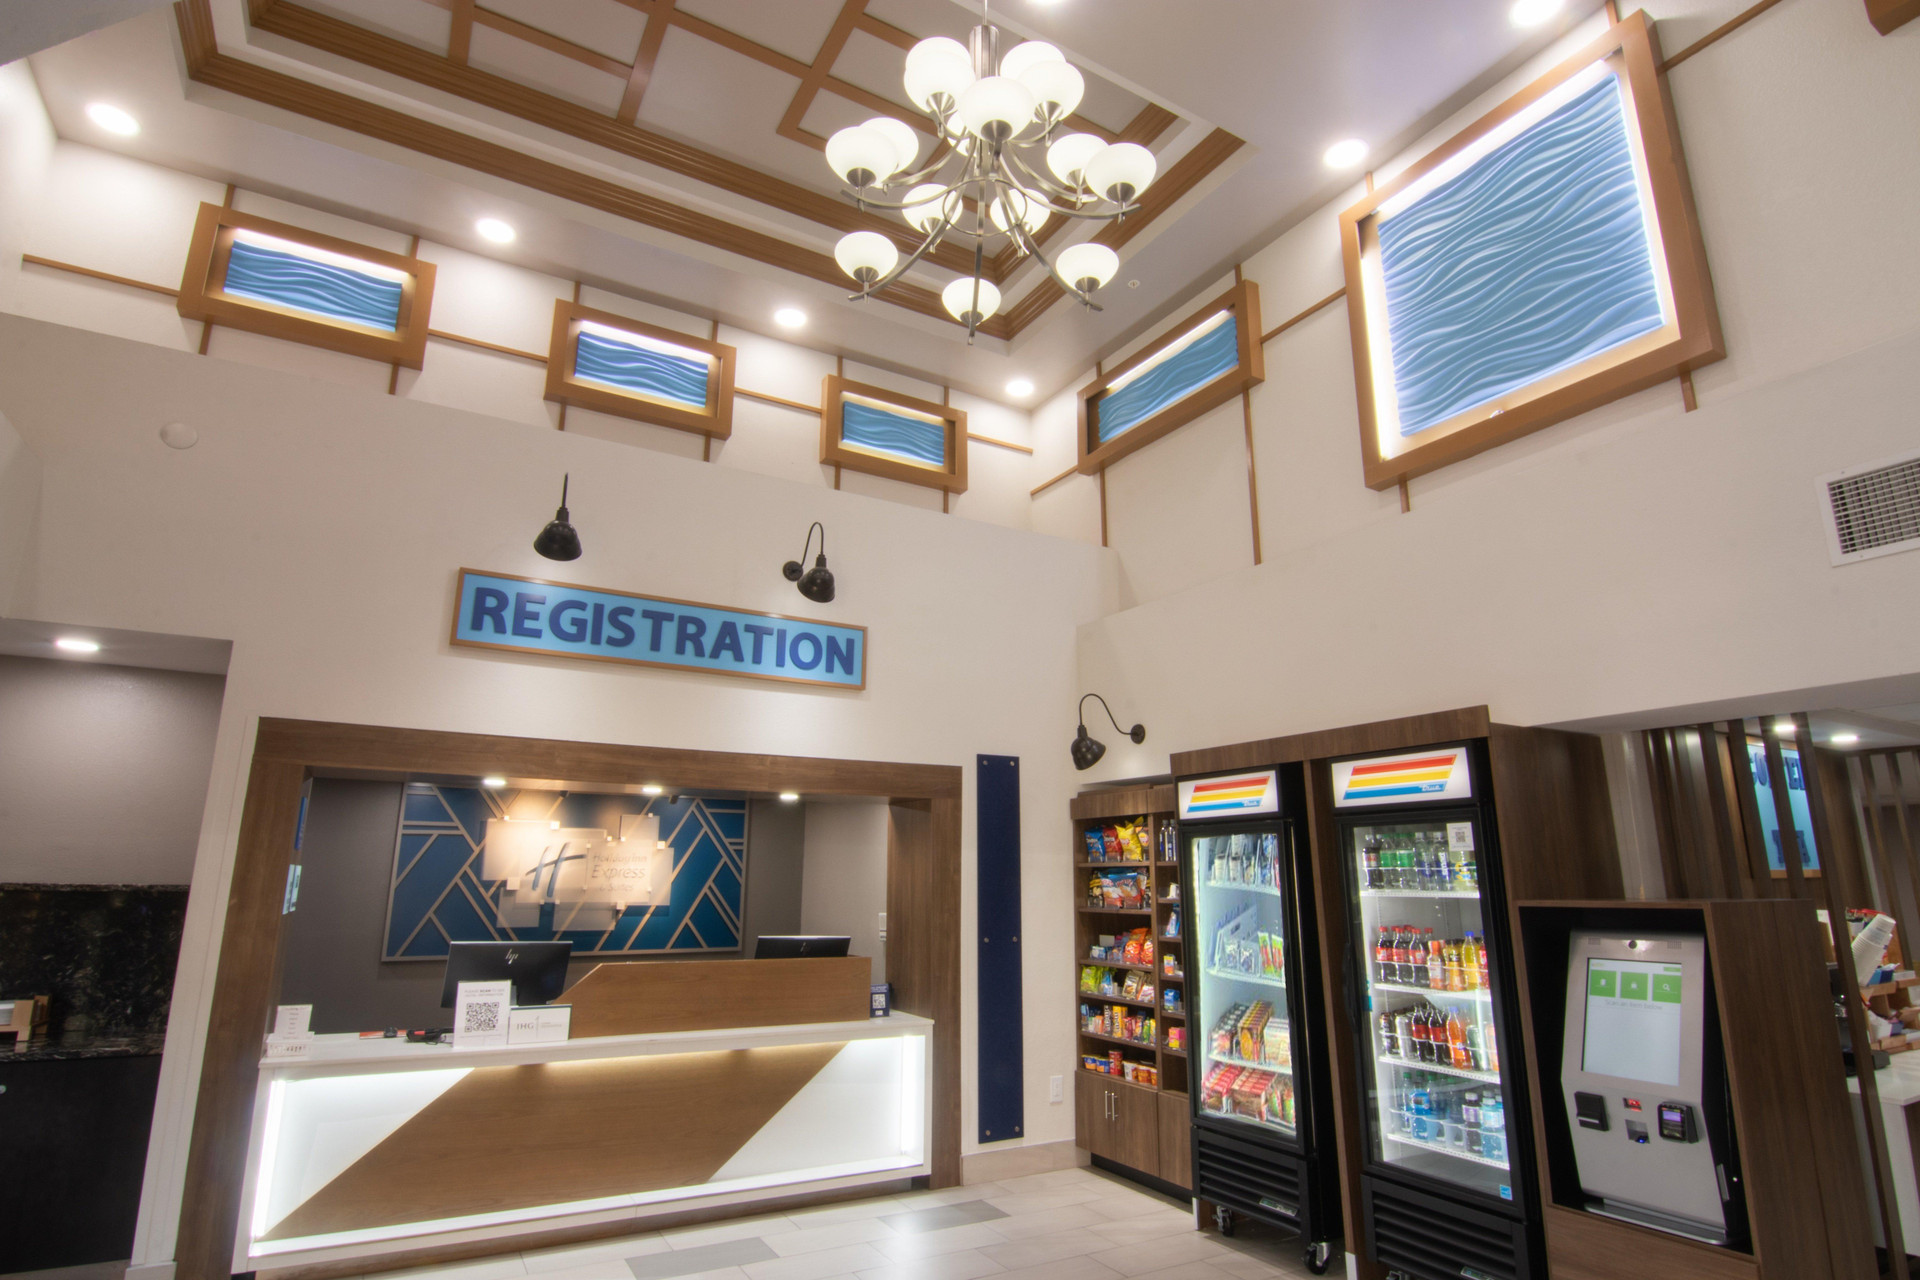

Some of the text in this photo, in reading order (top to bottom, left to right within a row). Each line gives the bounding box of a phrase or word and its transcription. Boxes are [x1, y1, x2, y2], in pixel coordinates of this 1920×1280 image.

[470, 586, 855, 675] REGISTRATION
[591, 864, 646, 880] Express
[505, 948, 519, 965] hp
[516, 1022, 535, 1031] IHG
